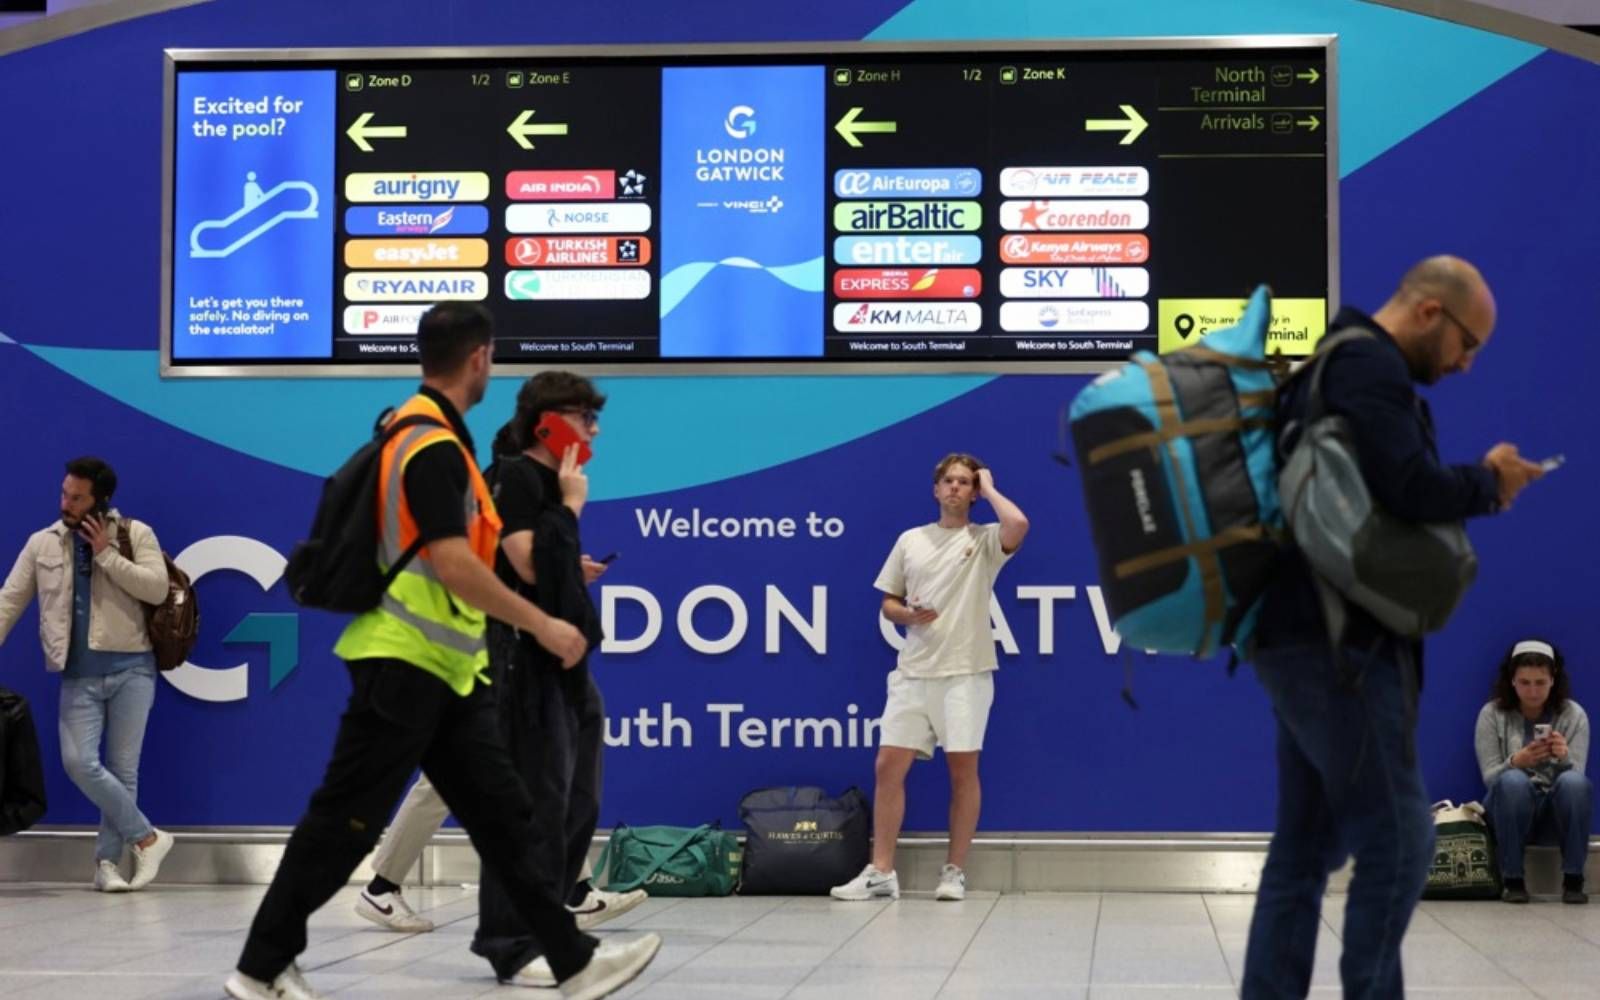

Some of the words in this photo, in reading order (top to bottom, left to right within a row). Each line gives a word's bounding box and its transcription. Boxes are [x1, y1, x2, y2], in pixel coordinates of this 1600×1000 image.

[369, 75, 398, 87] Zone
[401, 75, 412, 86] D
[472, 74, 490, 86] 1/2
[529, 73, 559, 84] Zone
[562, 73, 570, 83] E
[857, 70, 887, 82] Zone
[891, 70, 901, 81] H
[962, 69, 983, 81] 1/2
[1023, 68, 1055, 80] Zone
[1056, 68, 1065, 79] K
[1215, 67, 1266, 82] North
[1191, 87, 1266, 103] Terminal
[193, 97, 268, 115] Excited
[273, 96, 303, 114] for
[193, 120, 227, 136] the
[233, 118, 286, 140] pool?
[1201, 115, 1265, 130] Arrivals
[696, 149, 784, 164] LONDON
[696, 166, 784, 181] GATWICK
[1080, 172, 1138, 184] PEACE
[374, 174, 460, 199] aurigny
[520, 182, 547, 192] AIR
[551, 182, 592, 192] INDIA
[872, 174, 949, 193] AirEuropa
[378, 211, 432, 225] Eastern
[564, 213, 609, 223] NORSE
[851, 203, 964, 229] airBaltic
[1047, 210, 1131, 226] corendon
[546, 239, 608, 250] TURKISH
[853, 236, 949, 263] enter
[1031, 242, 1070, 256] Kenya
[1072, 240, 1122, 255] Airways
[374, 243, 459, 265] easyJet
[546, 252, 607, 263] AIRLINES
[841, 278, 909, 291] EXPRESS
[1024, 270, 1068, 287] SKY
[372, 279, 475, 294] RYANAIR
[190, 297, 222, 308] Let's
[223, 297, 242, 310] get
[245, 298, 268, 310] you
[270, 297, 303, 308] there
[190, 311, 229, 323] safely.
[232, 311, 250, 321] No
[253, 310, 290, 324] diving
[293, 312, 308, 321] on
[870, 311, 901, 324] KM
[905, 310, 967, 324] MALTA
[1199, 315, 1216, 323] You
[1282, 315, 1290, 323] in
[190, 325, 211, 334] the
[213, 324, 274, 335] escalator!
[1268, 327, 1308, 340] minal
[359, 344, 397, 352] Welcome
[399, 344, 408, 352] to
[520, 342, 559, 351] Welcome
[561, 342, 570, 351] to
[572, 342, 597, 350] South
[598, 341, 634, 350] Terminal
[849, 341, 889, 350] Welcome
[890, 341, 900, 350] to
[903, 341, 928, 350] South
[929, 341, 966, 350] Terminal
[1016, 340, 1055, 350] Welcome
[1057, 341, 1067, 350] to
[1069, 340, 1094, 350] South
[1096, 340, 1133, 349] Terminal
[635, 507, 797, 538] Welcome
[806, 511, 845, 538] to
[600, 584, 828, 655] DON
[603, 703, 692, 748] uth
[706, 703, 882, 748] Termi
